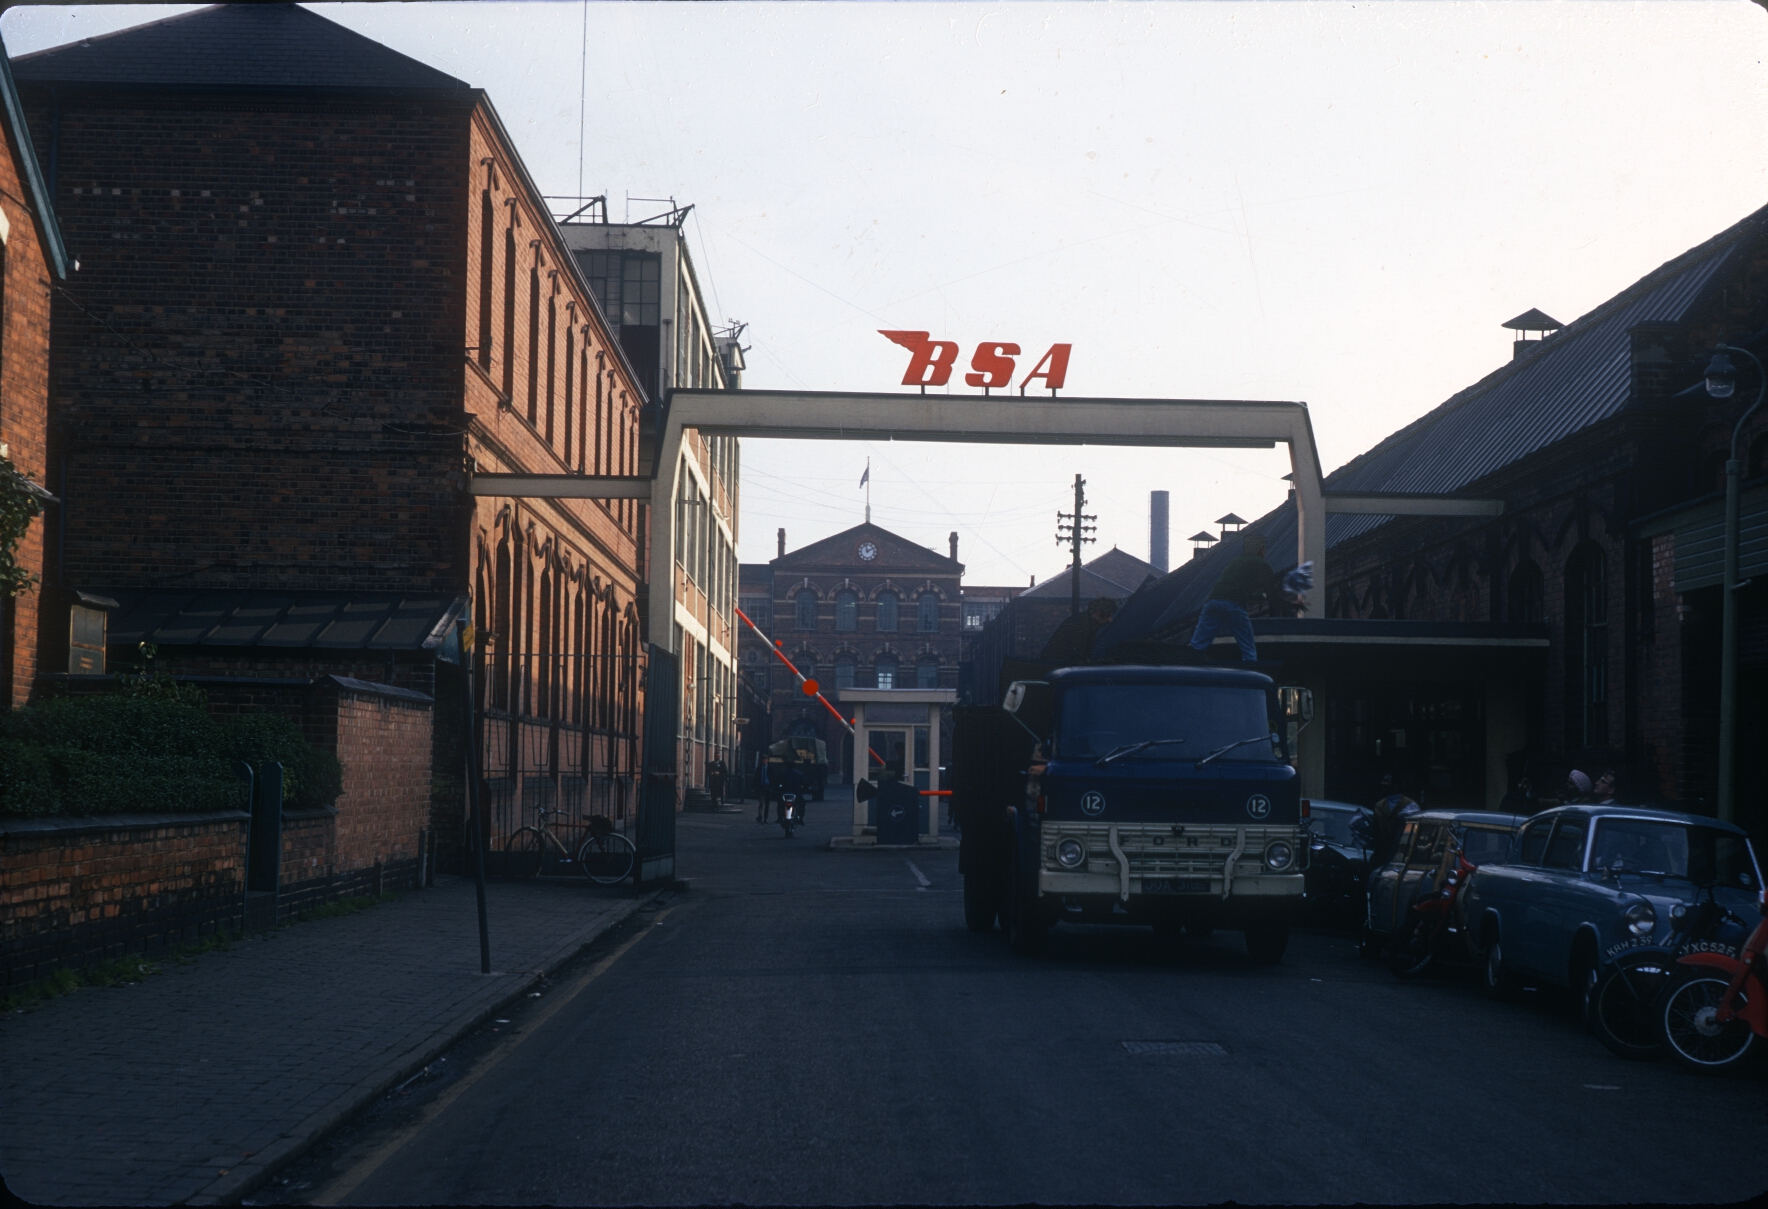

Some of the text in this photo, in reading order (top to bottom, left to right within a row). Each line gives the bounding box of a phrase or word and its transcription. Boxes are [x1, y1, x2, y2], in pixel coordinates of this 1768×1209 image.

[877, 330, 1072, 388] BSA
[1086, 795, 1101, 810] 12
[1252, 799, 1266, 813] 12
[1119, 834, 1232, 847] FORD
[1606, 935, 1653, 957] KRH 239
